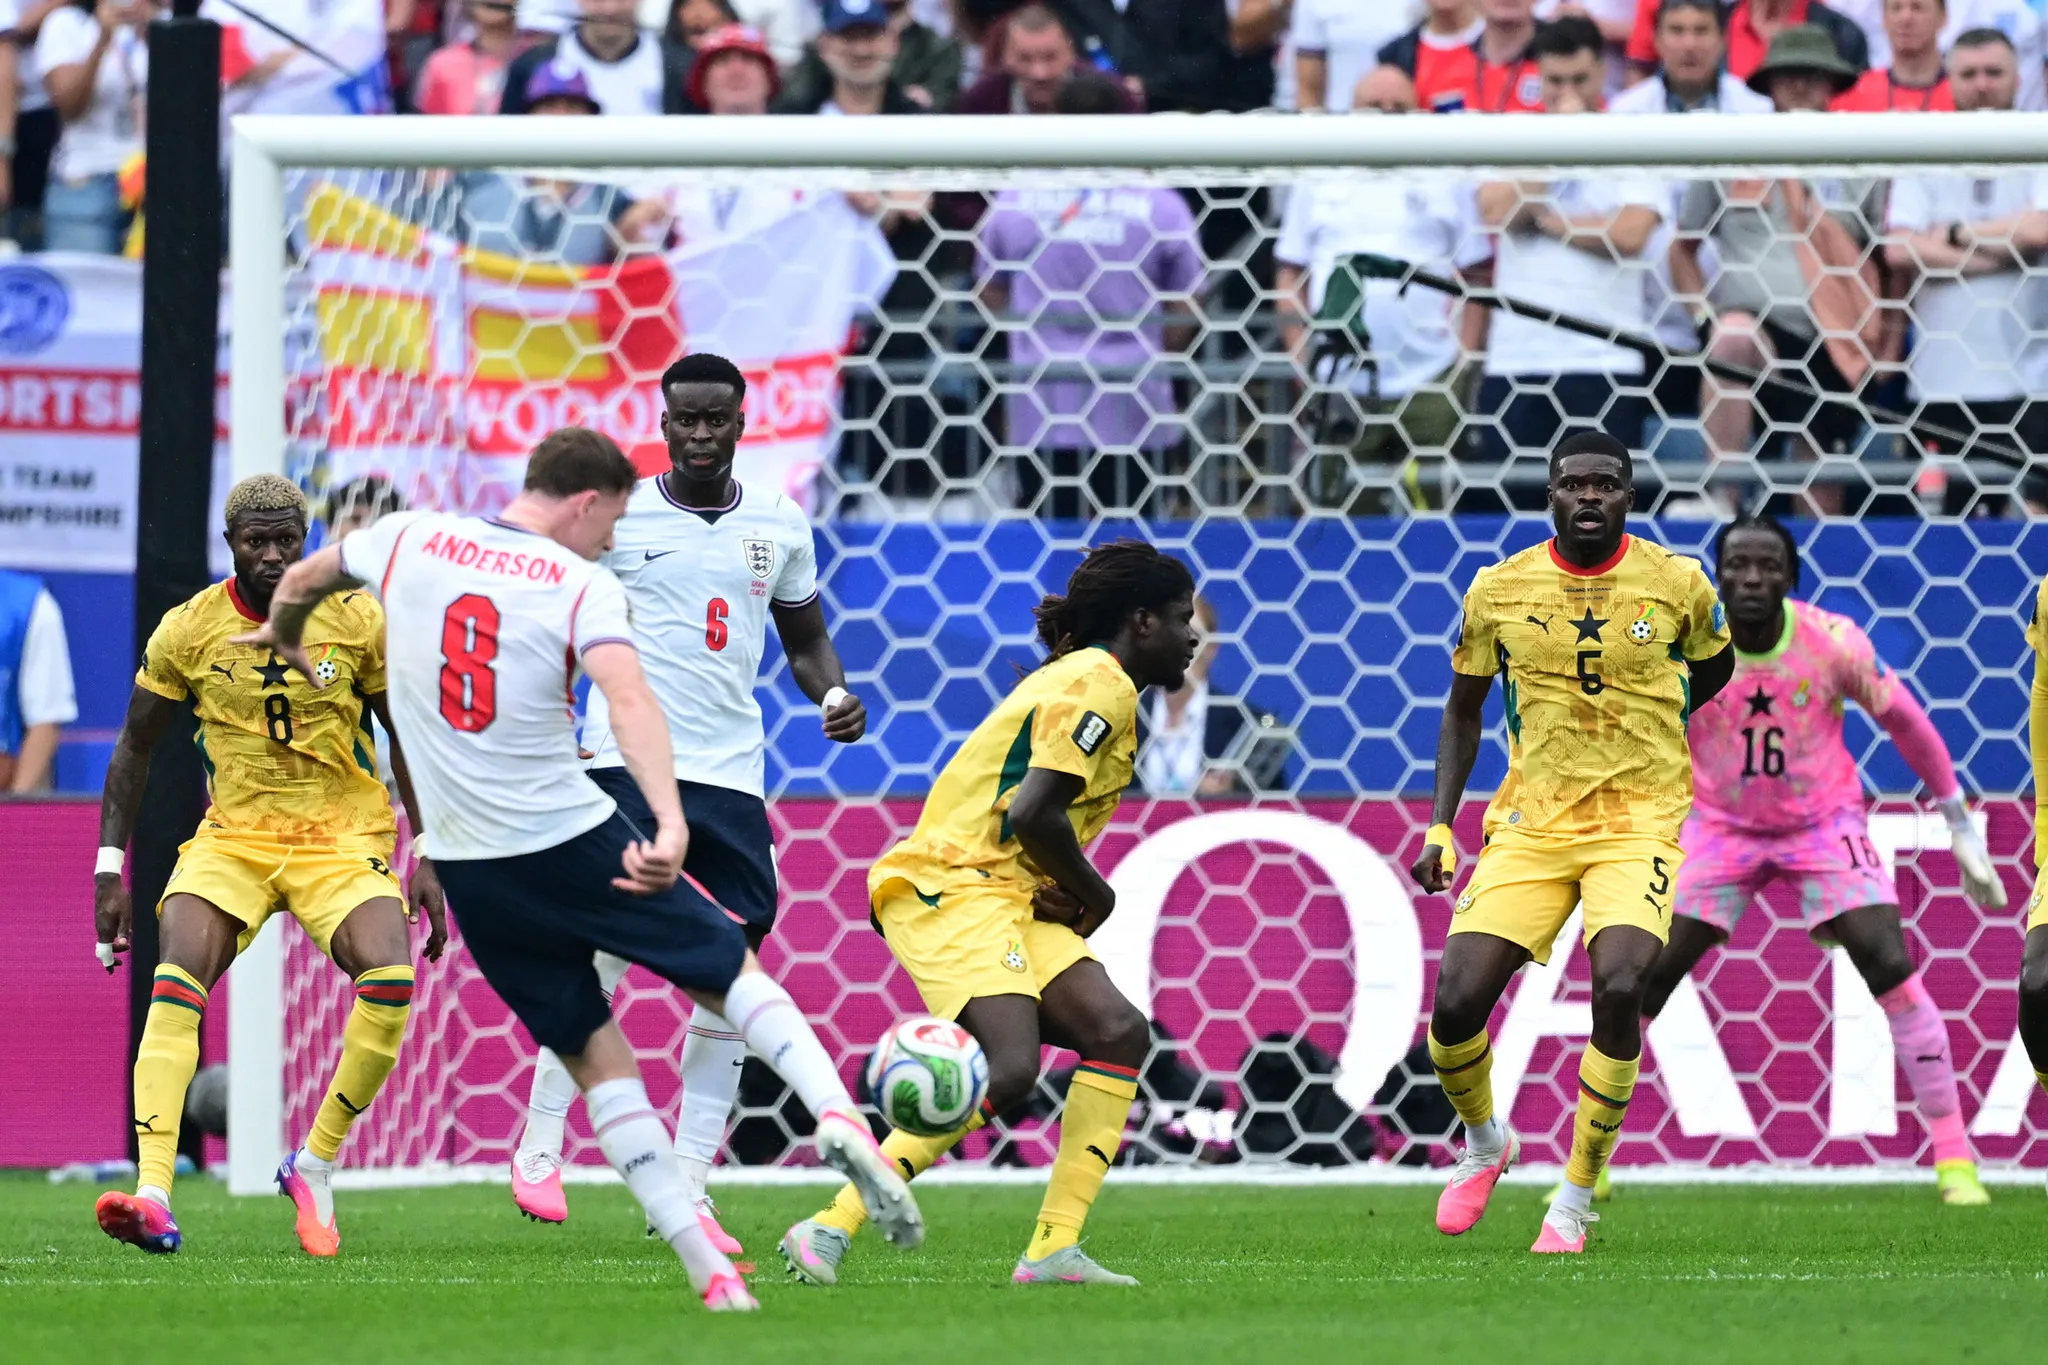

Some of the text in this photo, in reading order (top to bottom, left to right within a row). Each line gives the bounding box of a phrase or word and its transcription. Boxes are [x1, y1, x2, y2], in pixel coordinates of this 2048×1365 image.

[423, 531, 566, 584] ANDERSON
[705, 597, 728, 652] 6
[440, 593, 501, 733] 8
[1577, 650, 1605, 695] 5
[265, 693, 293, 745] 8
[1741, 726, 1785, 777] 16
[1649, 856, 1669, 895] 5
[1841, 836, 1880, 870] 16
[624, 1151, 656, 1174] ENG
